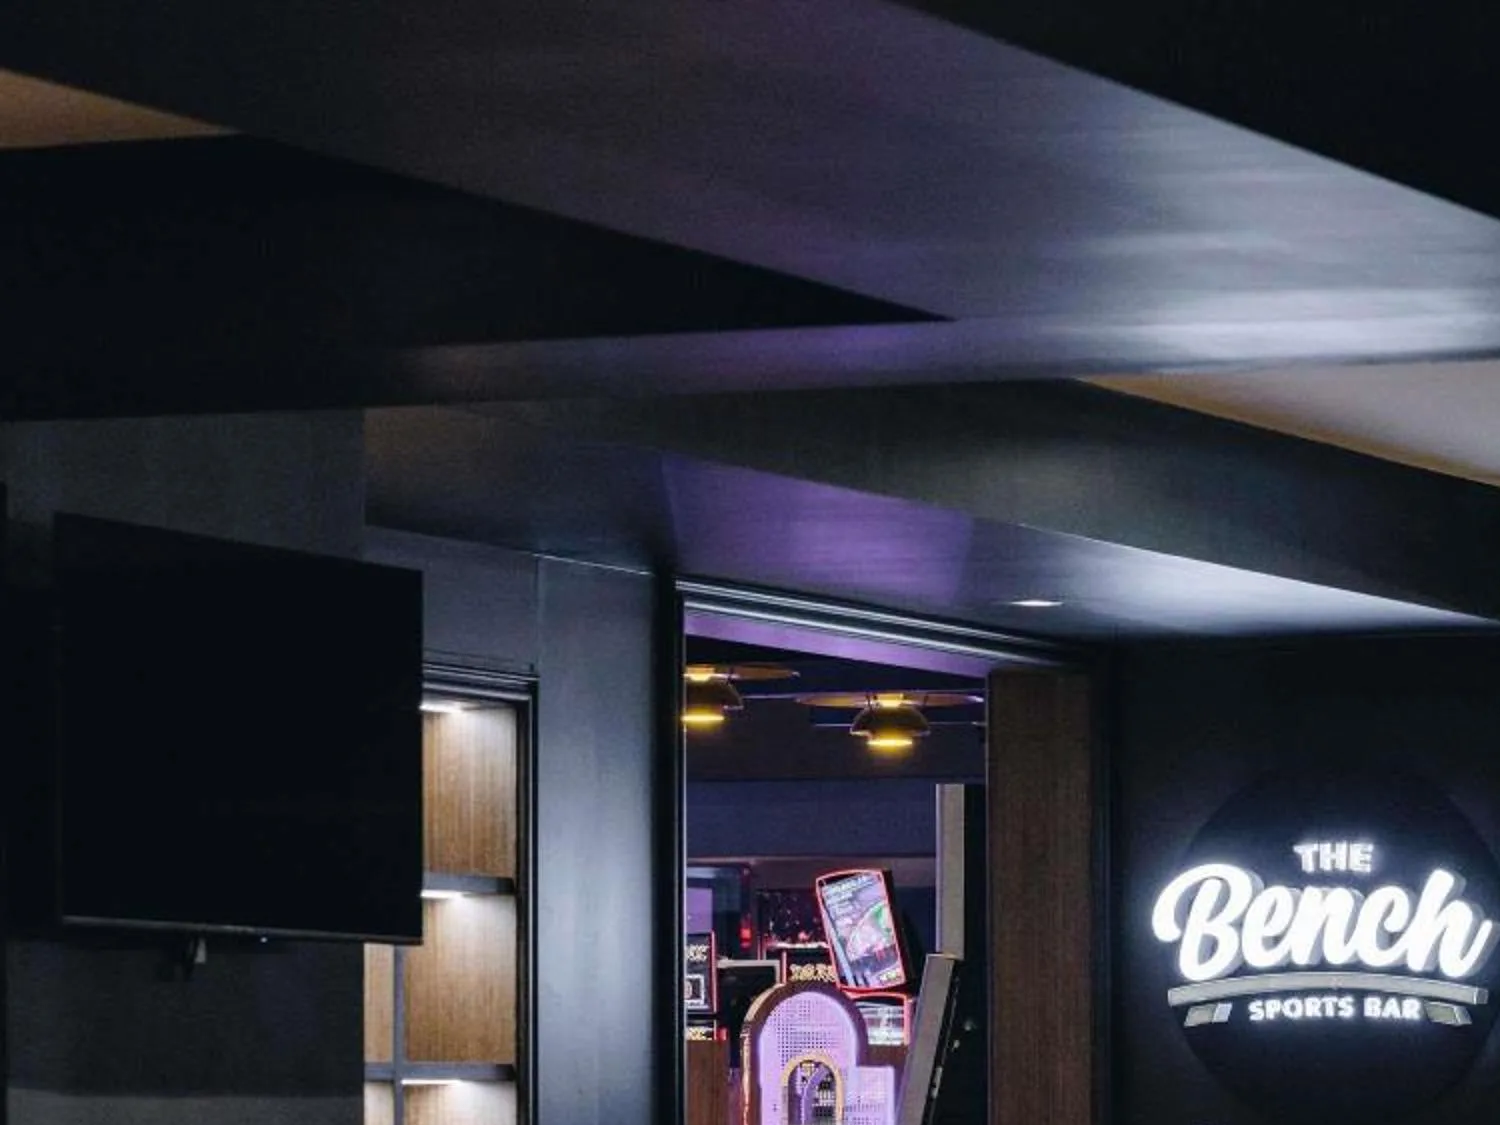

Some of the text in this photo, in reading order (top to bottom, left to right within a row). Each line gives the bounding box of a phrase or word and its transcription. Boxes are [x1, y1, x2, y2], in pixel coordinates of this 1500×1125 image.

[1293, 842, 1374, 873] THE
[1247, 996, 1421, 1021] SPORTS BAR
